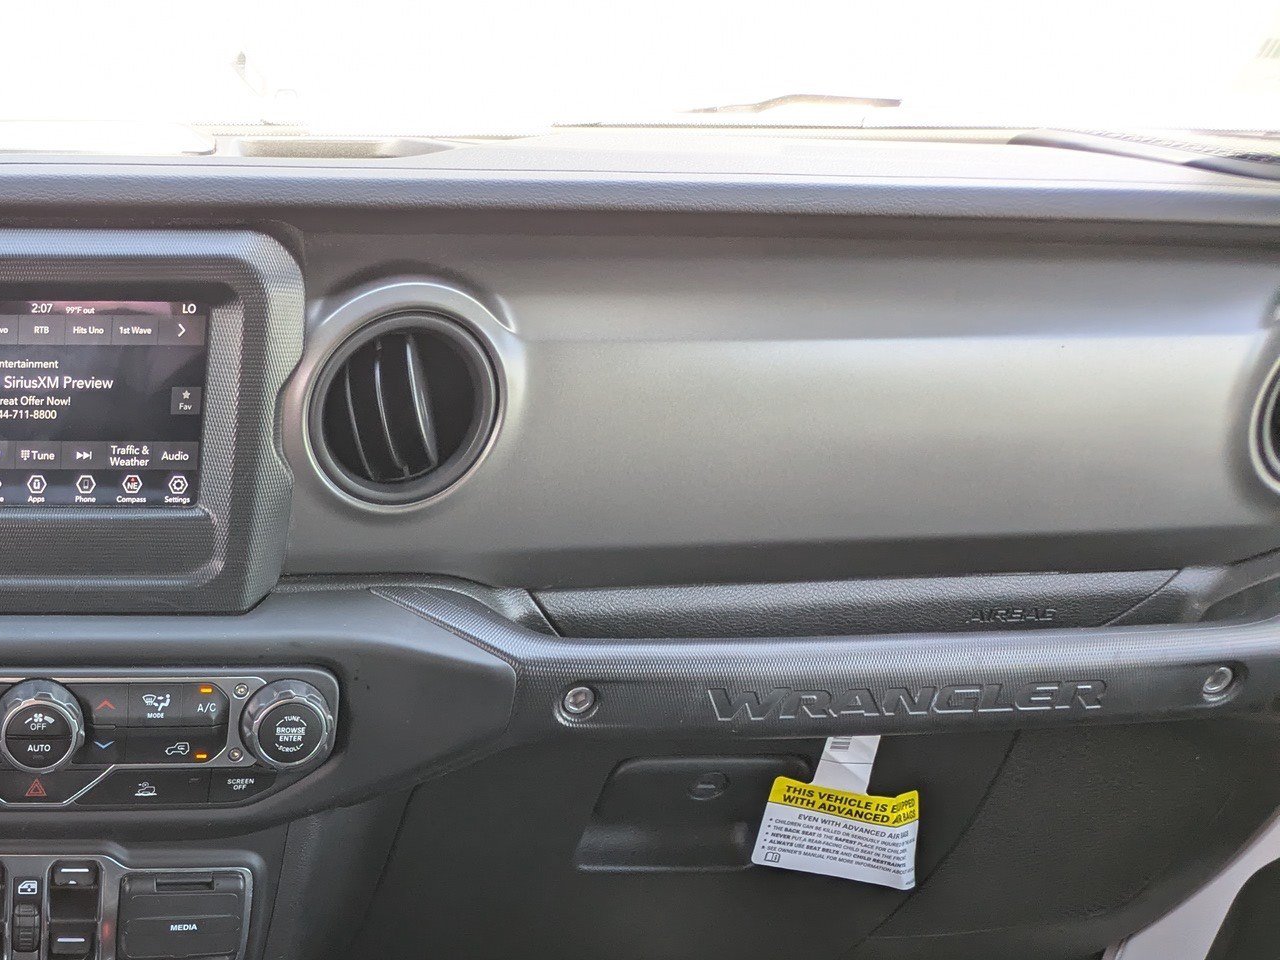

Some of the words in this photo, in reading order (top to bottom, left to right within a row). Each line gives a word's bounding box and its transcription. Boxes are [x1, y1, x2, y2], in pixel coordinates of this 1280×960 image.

[31, 303, 53, 313] 2:07
[182, 304, 197, 314] LO
[34, 326, 49, 334] RTB
[73, 326, 87, 334] Hits
[88, 326, 104, 334] Uno
[119, 326, 130, 334] 1st
[132, 326, 152, 334] Wave
[4, 376, 59, 389] SiriusXM
[63, 376, 114, 389] Preview
[20, 396, 44, 406] Offer
[47, 397, 71, 406] Now!
[179, 403, 192, 411] Fav
[111, 445, 135, 455] Traffic
[139, 445, 149, 455] &
[32, 451, 55, 460] Tune
[161, 451, 189, 461] Audio
[110, 457, 149, 466] Weather
[707, 679, 1107, 721] WRANGLER
[197, 702, 217, 712] A/C
[30, 723, 47, 731] OFF
[27, 744, 51, 752] AUTO
[786, 785, 814, 797] THIS
[818, 792, 873, 810] VEHICLE
[875, 803, 888, 812] IS
[783, 794, 815, 807] WITH
[818, 803, 890, 823] ADVANCED
[798, 814, 819, 822] EVEN
[821, 818, 841, 827] WITH
[842, 823, 886, 837] ADVANCED
[771, 832, 791, 840] NEVER
[775, 819, 801, 827] CHILDREN
[851, 833, 879, 844] SERIOUSLY
[769, 839, 793, 847] ALWAYS
[170, 923, 198, 932] MEDIA
